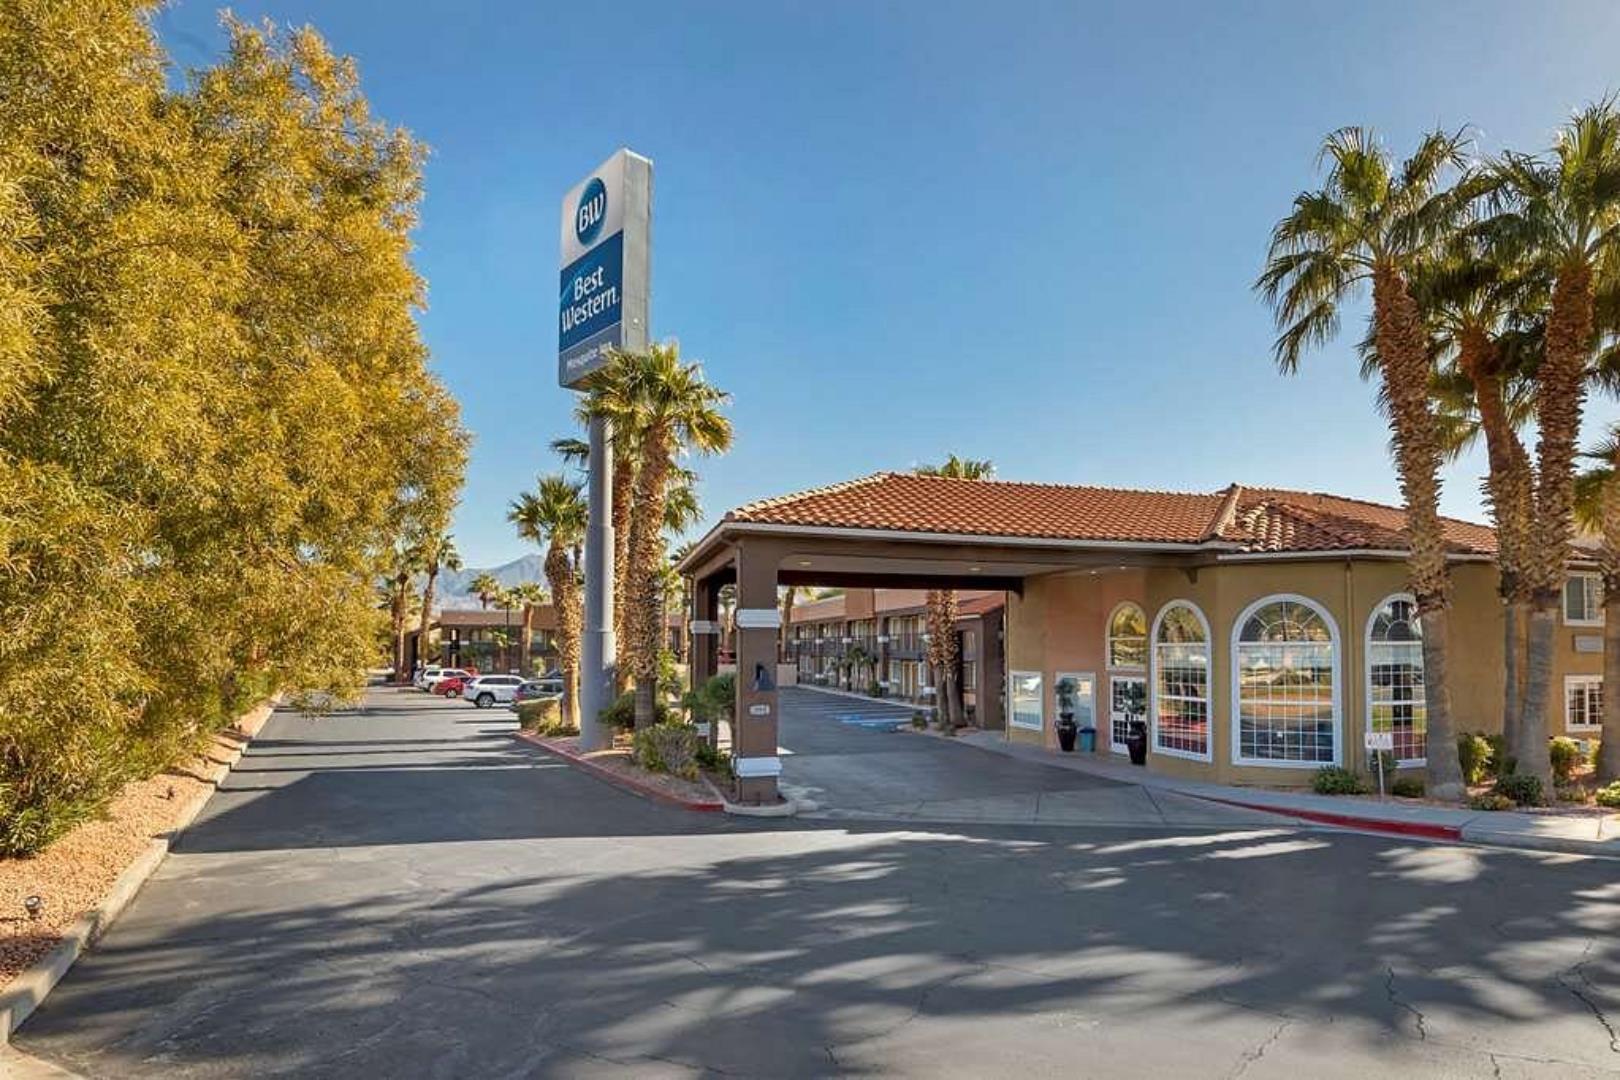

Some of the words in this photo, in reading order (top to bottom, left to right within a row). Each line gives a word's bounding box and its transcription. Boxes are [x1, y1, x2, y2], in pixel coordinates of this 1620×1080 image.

[579, 192, 604, 233] BW
[574, 265, 604, 301] Best
[561, 286, 616, 333] Western
